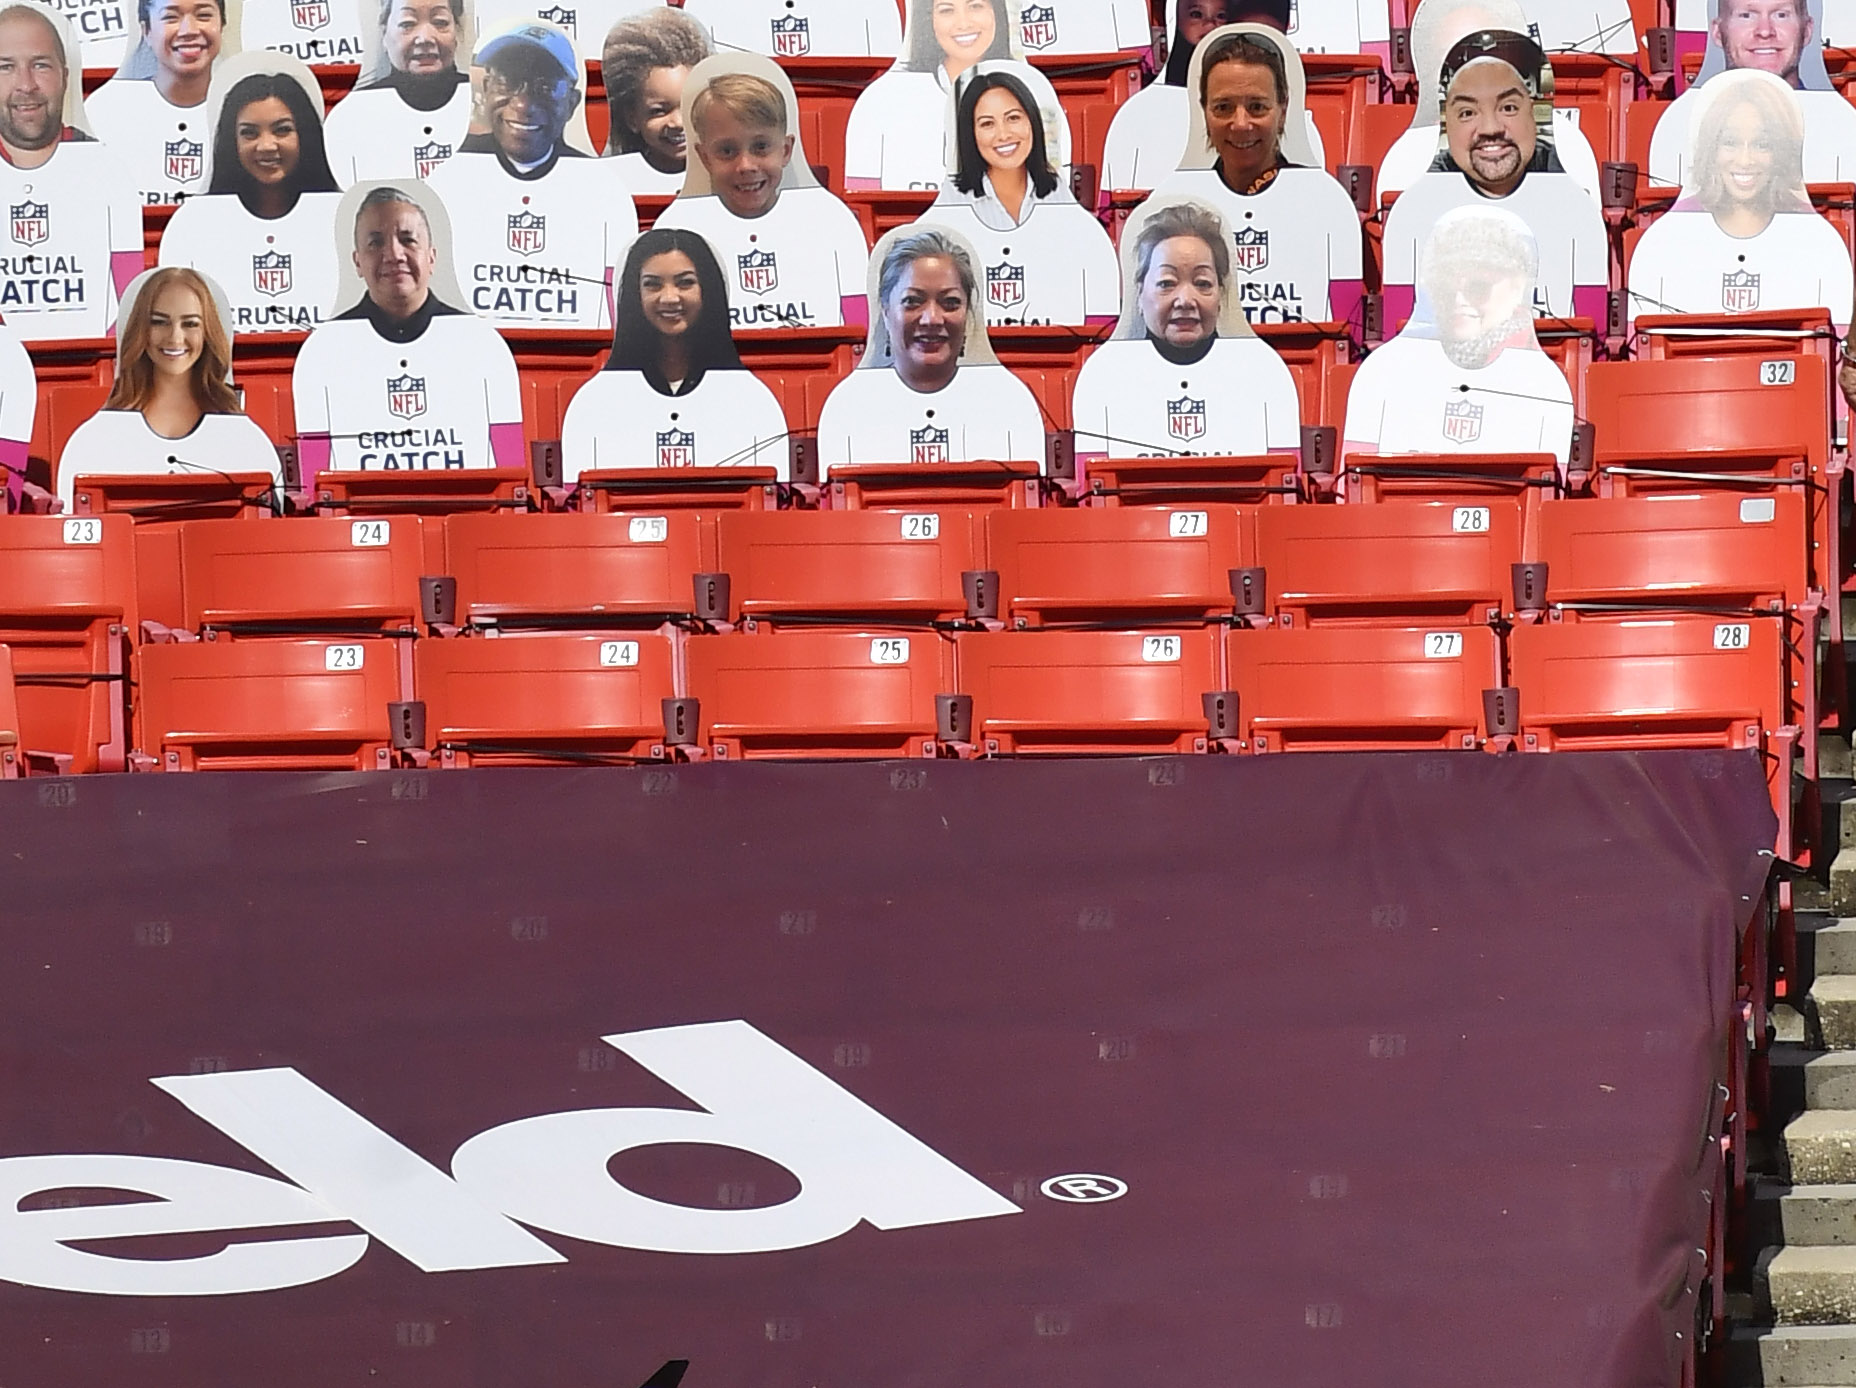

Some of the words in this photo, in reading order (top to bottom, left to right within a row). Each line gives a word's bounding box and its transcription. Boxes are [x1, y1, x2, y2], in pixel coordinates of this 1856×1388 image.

[295, 4, 326, 25] NFL
[1021, 23, 1053, 44] NFL
[168, 156, 198, 177] NFL
[15, 219, 45, 240] NFL
[511, 229, 540, 250] NFL
[257, 269, 288, 290] NFL
[473, 264, 578, 287] CRUCIAL
[743, 268, 773, 289] NFL
[472, 286, 578, 316] CATCH
[990, 281, 1020, 302] NFL
[1767, 363, 1789, 383] 32
[392, 393, 423, 414] NFL
[1171, 415, 1202, 436] NFL
[357, 429, 464, 450] CRUCIAL
[909, 517, 932, 537] 26
[1178, 514, 1200, 534] 27
[1460, 510, 1482, 529] 28
[71, 521, 94, 541] 23
[359, 524, 382, 543] 24
[1433, 635, 1455, 654] 27
[1720, 626, 1742, 647] 28
[333, 647, 356, 668] 23
[608, 644, 631, 664] 24
[879, 641, 901, 660] 25
[1150, 638, 1174, 658] 26
